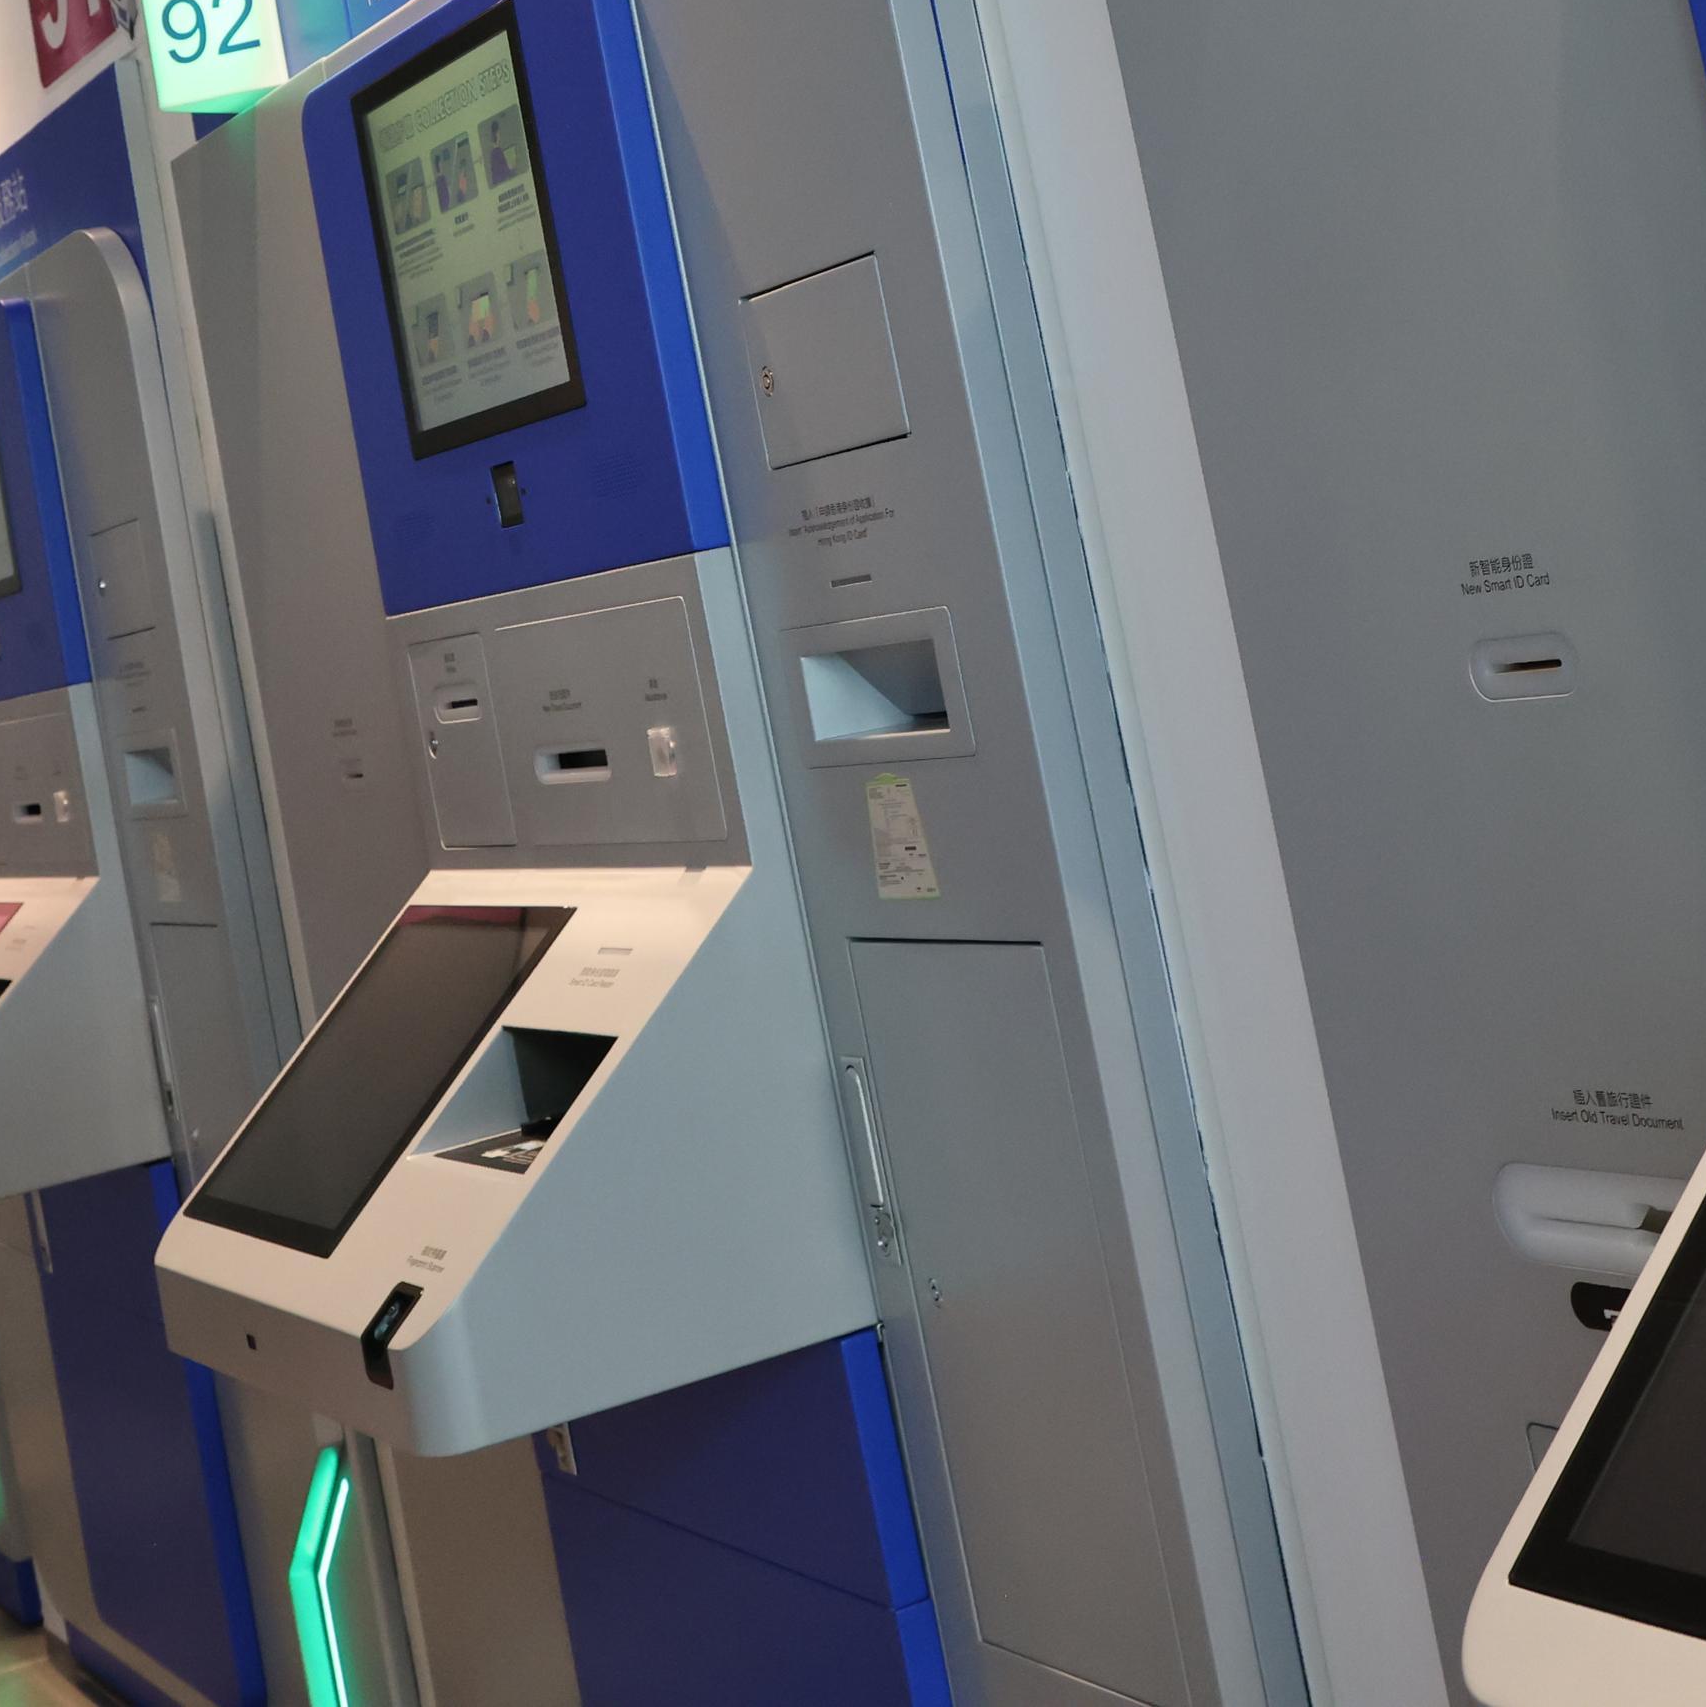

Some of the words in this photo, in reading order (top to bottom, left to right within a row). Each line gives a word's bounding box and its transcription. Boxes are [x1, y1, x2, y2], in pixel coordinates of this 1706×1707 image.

[1460, 580, 1481, 596] New
[1483, 578, 1512, 594] Smart
[1513, 575, 1525, 589] ID
[1526, 572, 1550, 587] Card
[1551, 1107, 1580, 1123] Insert
[1581, 1109, 1598, 1125] Old
[1600, 1110, 1630, 1127] Travel
[1632, 1113, 1685, 1131] Document
